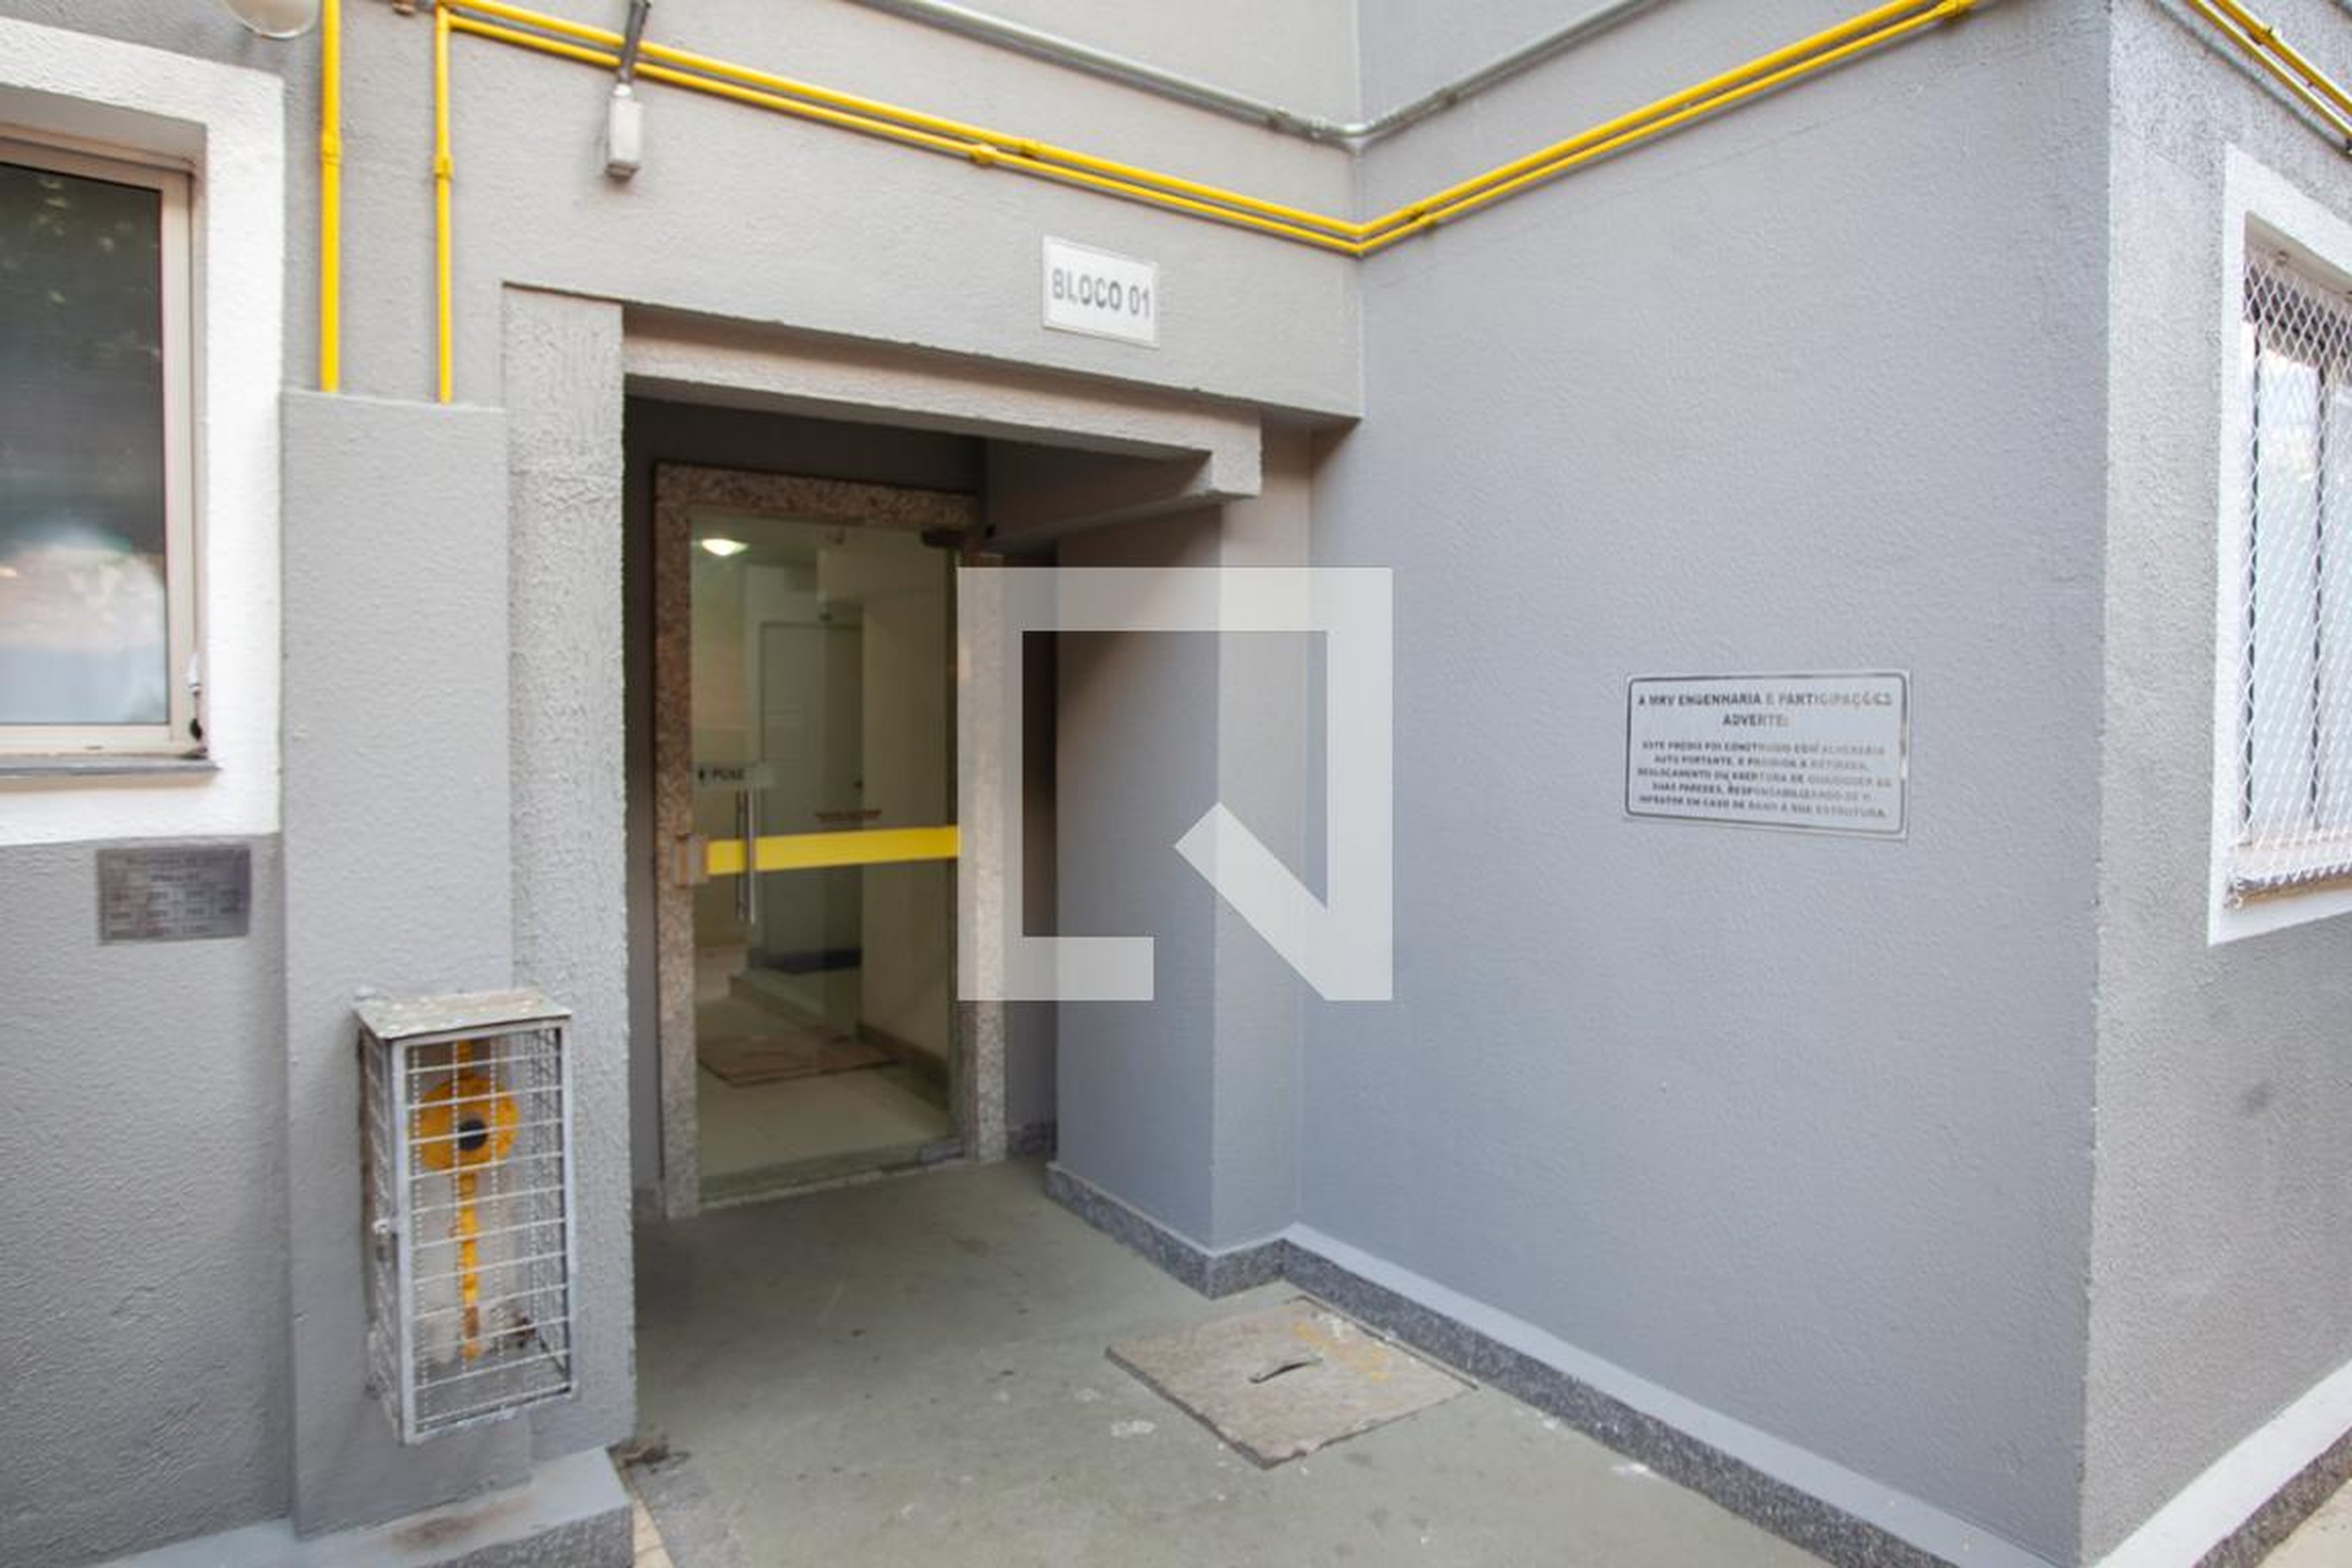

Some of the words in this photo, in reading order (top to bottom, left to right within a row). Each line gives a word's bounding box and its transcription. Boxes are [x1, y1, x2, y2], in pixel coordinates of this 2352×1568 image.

[1052, 266, 1122, 311] BLOCO
[1128, 284, 1150, 318] 01
[1678, 690, 1762, 705] ENGENHARIA
